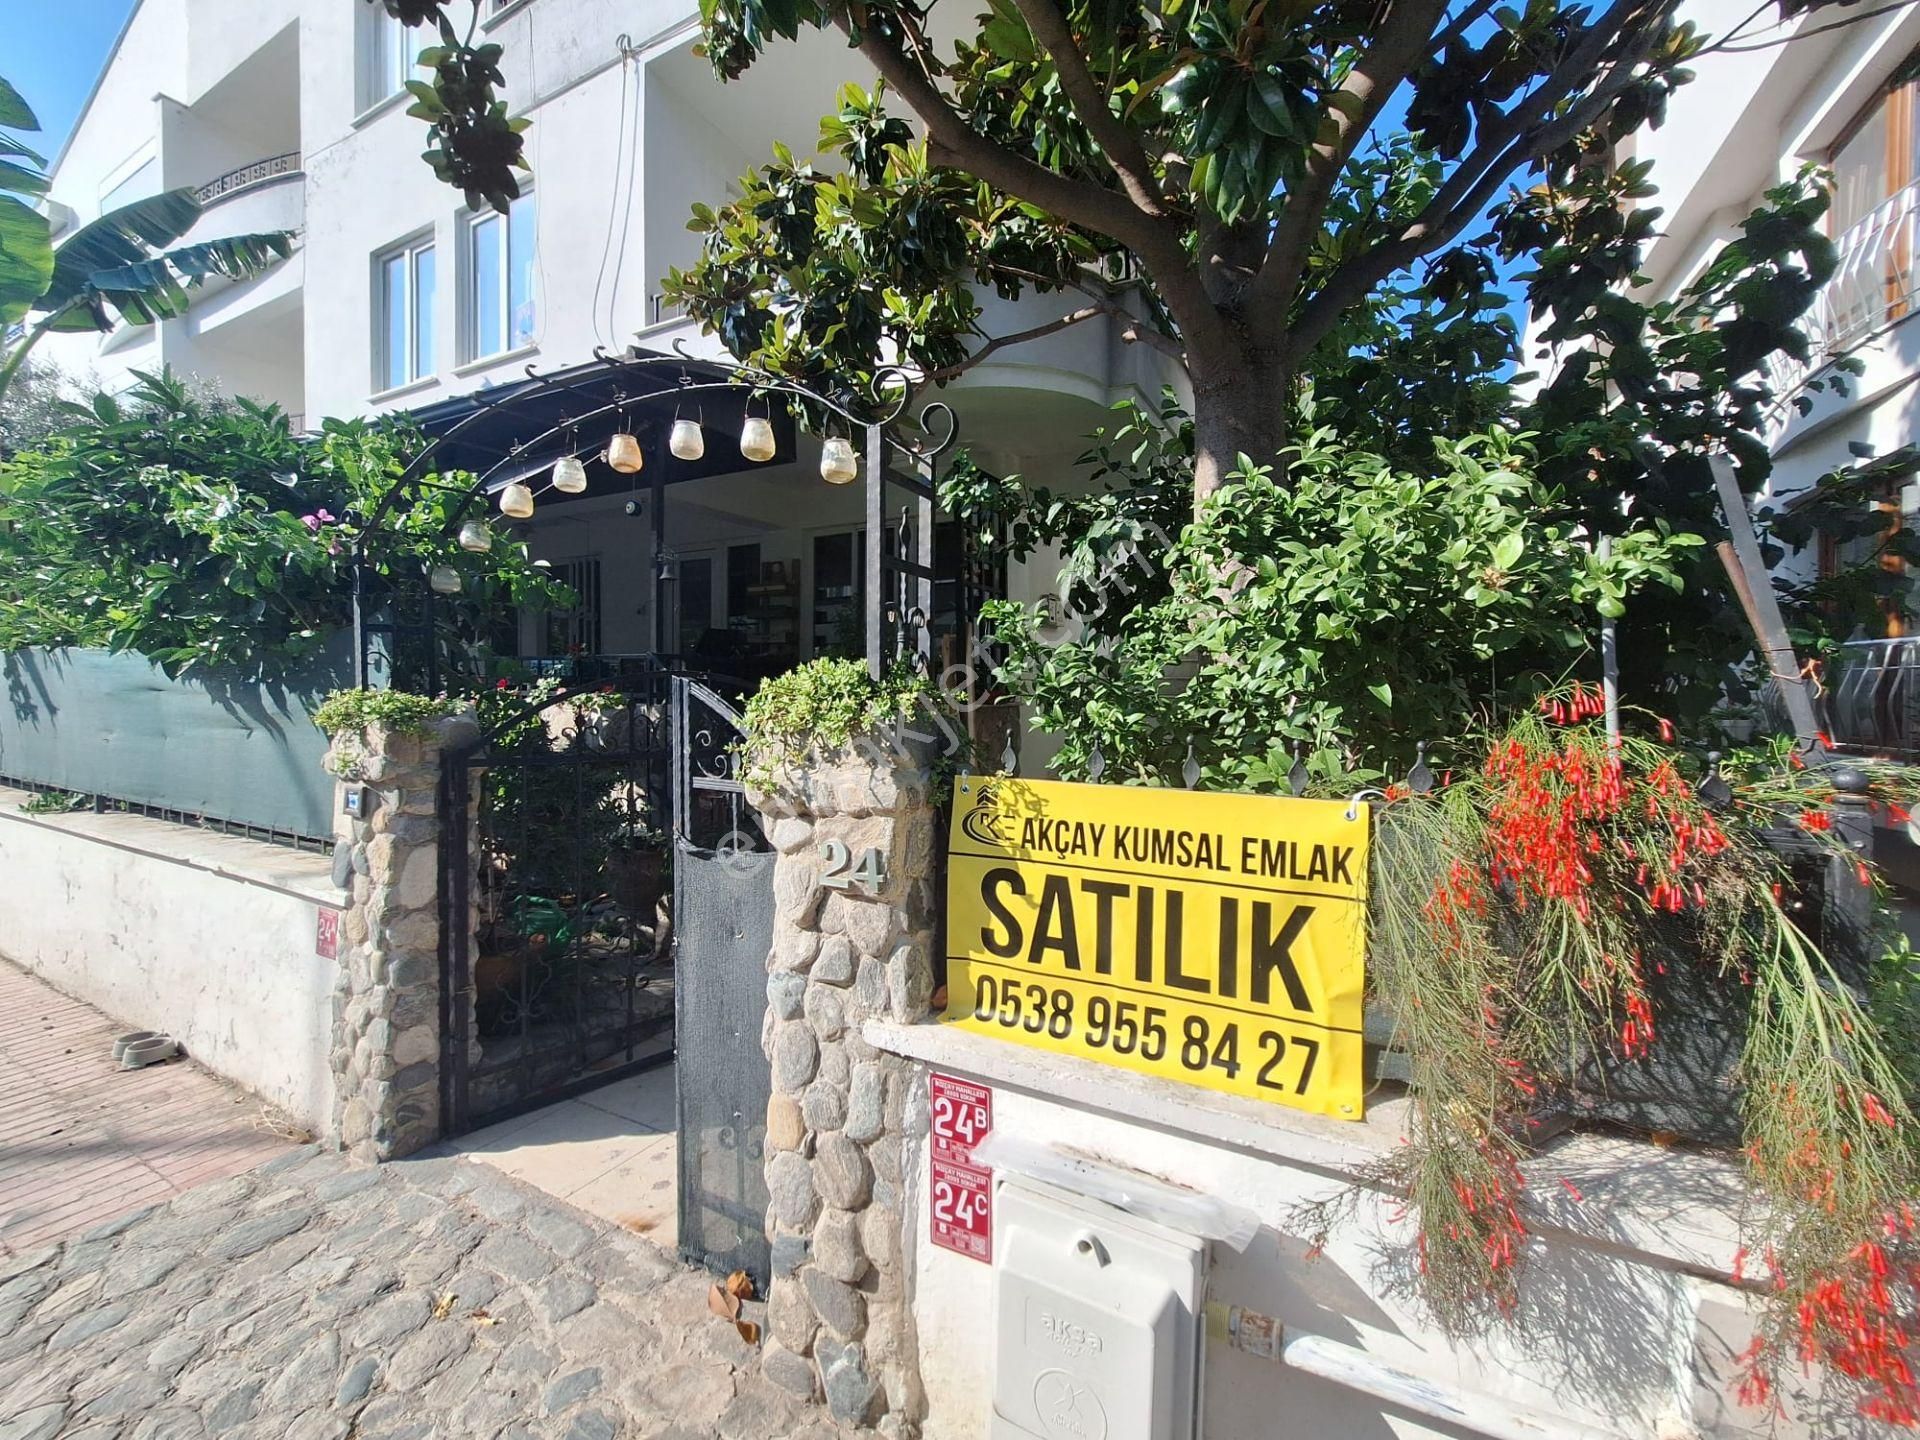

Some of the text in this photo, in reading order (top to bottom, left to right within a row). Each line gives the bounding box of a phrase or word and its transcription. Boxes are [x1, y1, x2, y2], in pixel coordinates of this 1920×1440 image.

[817, 840, 885, 893] 24
[1020, 817, 1353, 885] AKÇAY KUMSAL EMLAK
[980, 867, 1317, 1013] SATILIK
[974, 974, 1319, 1095] 0538 955 84 27
[1041, 1311, 1103, 1353] aksa
